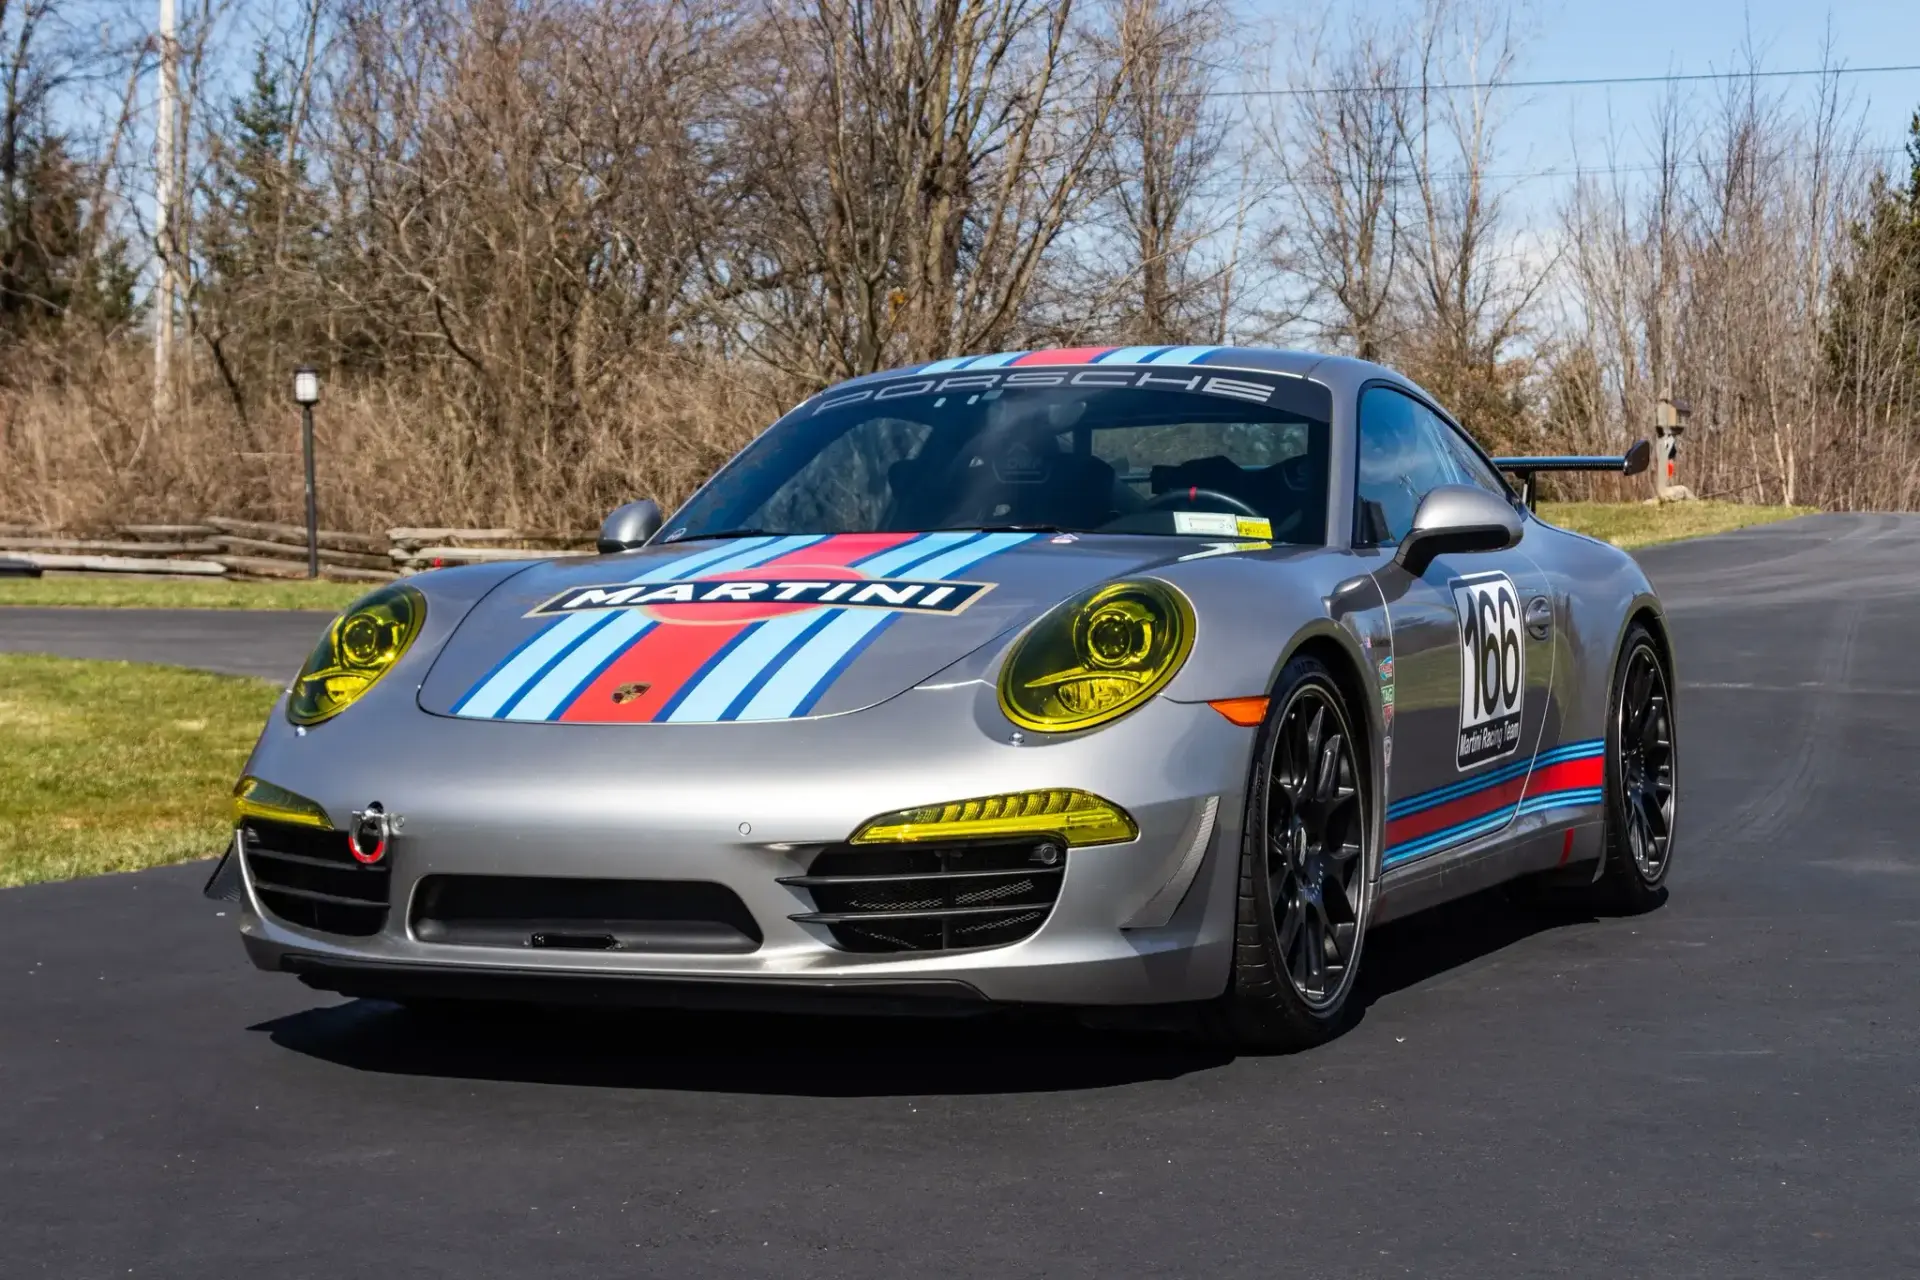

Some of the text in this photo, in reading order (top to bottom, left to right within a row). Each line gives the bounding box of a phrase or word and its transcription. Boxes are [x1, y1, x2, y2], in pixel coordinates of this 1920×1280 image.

[812, 371, 1276, 415] PORSCHE
[562, 583, 956, 608] MARTINI
[1465, 587, 1520, 720] 166
[1459, 720, 1519, 757] Martini Racing Team
